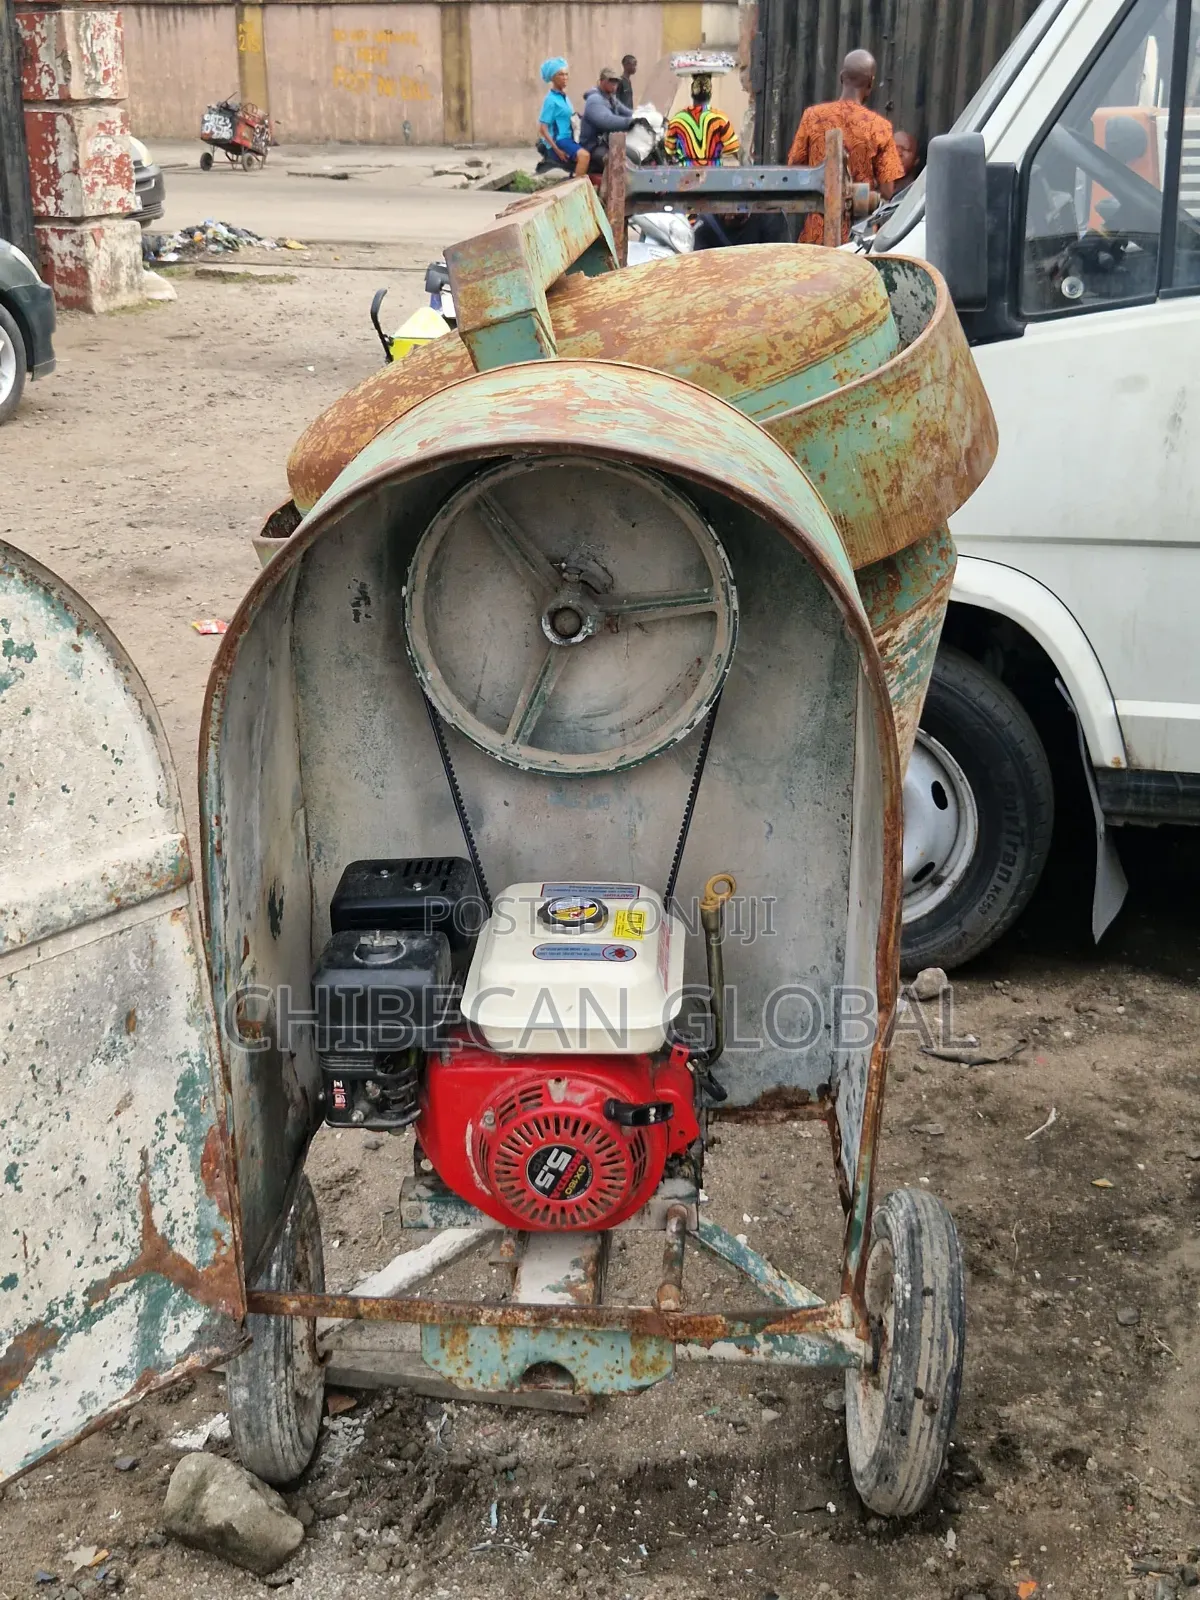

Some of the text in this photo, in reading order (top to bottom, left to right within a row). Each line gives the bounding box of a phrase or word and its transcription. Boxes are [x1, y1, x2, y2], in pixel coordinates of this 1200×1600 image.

[332, 64, 373, 96] POST
[534, 1147, 572, 1189] 5.5
[564, 1164, 587, 1195] GX160
